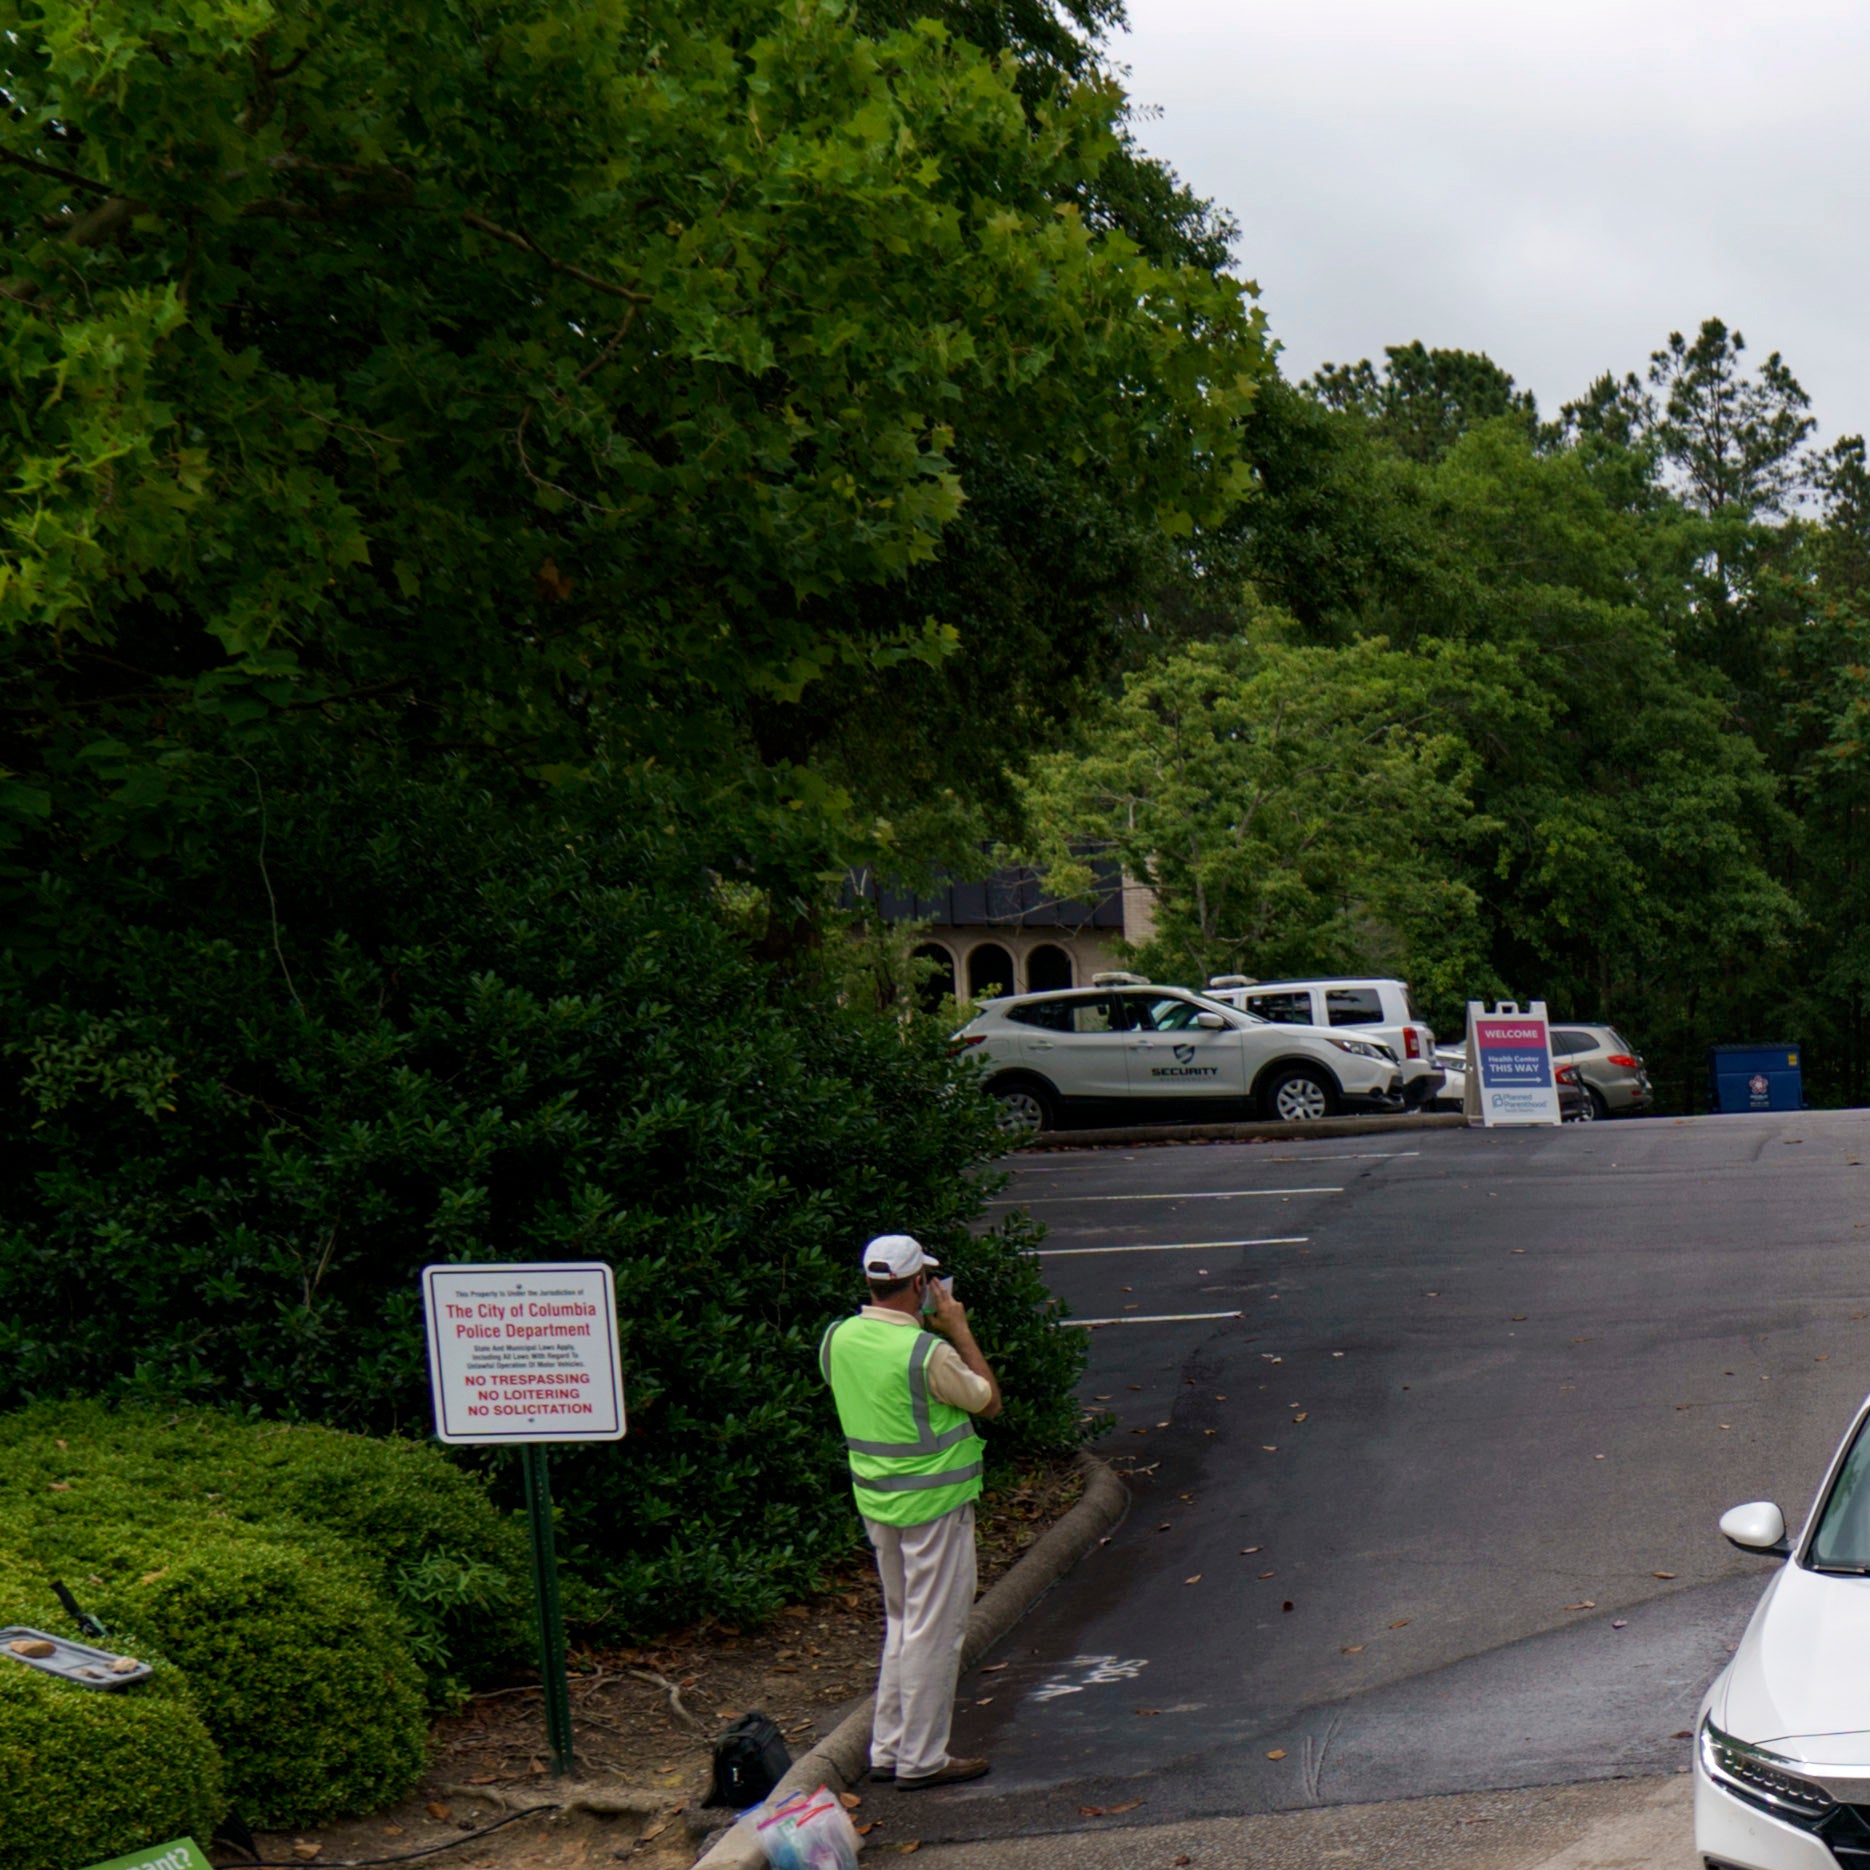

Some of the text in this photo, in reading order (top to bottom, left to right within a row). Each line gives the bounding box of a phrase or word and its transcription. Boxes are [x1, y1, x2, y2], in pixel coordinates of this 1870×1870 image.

[1484, 1029, 1539, 1039] WELCOME
[1152, 1067, 1217, 1076] SECURITY
[1489, 1064, 1540, 1073] THIS WAY
[446, 1301, 597, 1321] The City of Columbia
[456, 1322, 591, 1340] Police Department
[465, 1373, 590, 1386] NO TRESPASSING
[478, 1388, 580, 1401] NO LOITERING
[467, 1403, 593, 1416] NO SOLICITATION
